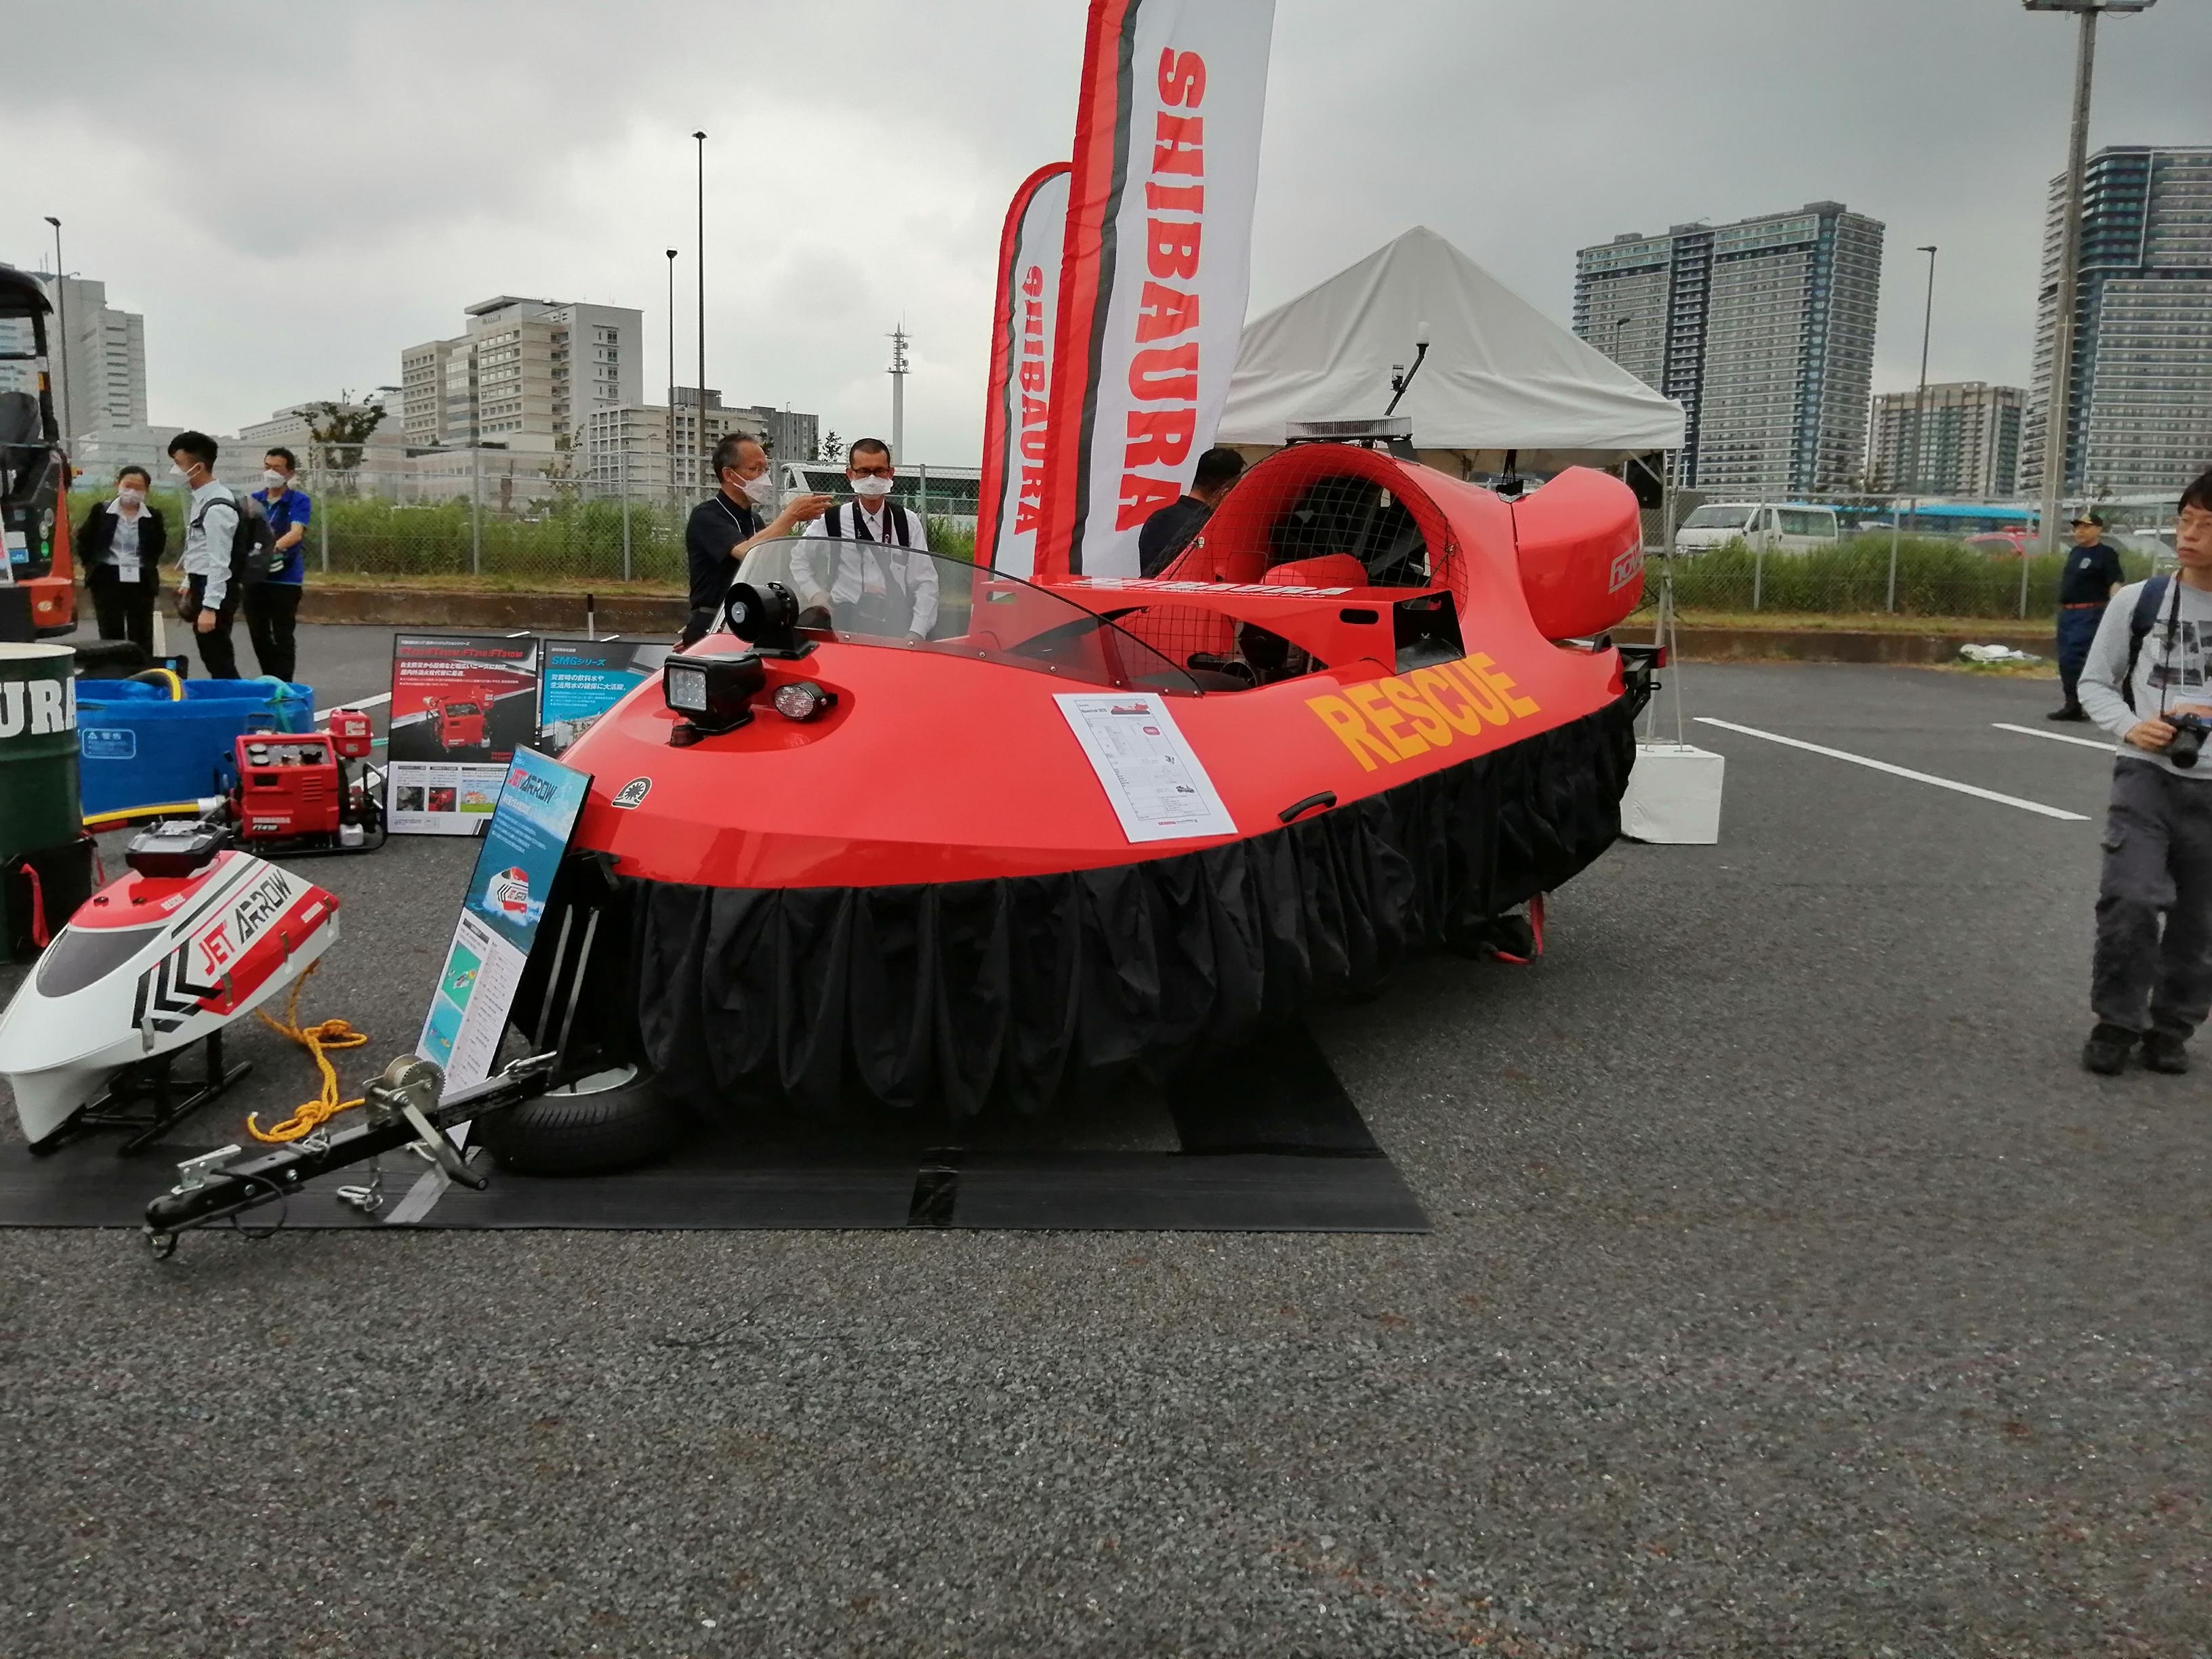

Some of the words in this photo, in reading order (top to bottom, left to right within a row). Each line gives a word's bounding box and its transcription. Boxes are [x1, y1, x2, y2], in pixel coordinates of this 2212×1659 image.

[1115, 47, 1207, 532] SHIBAURA
[1305, 653, 1540, 773] RESCUE
[520, 774, 558, 804] ARROW
[199, 919, 235, 977] JET
[234, 869, 292, 945] ARROW
